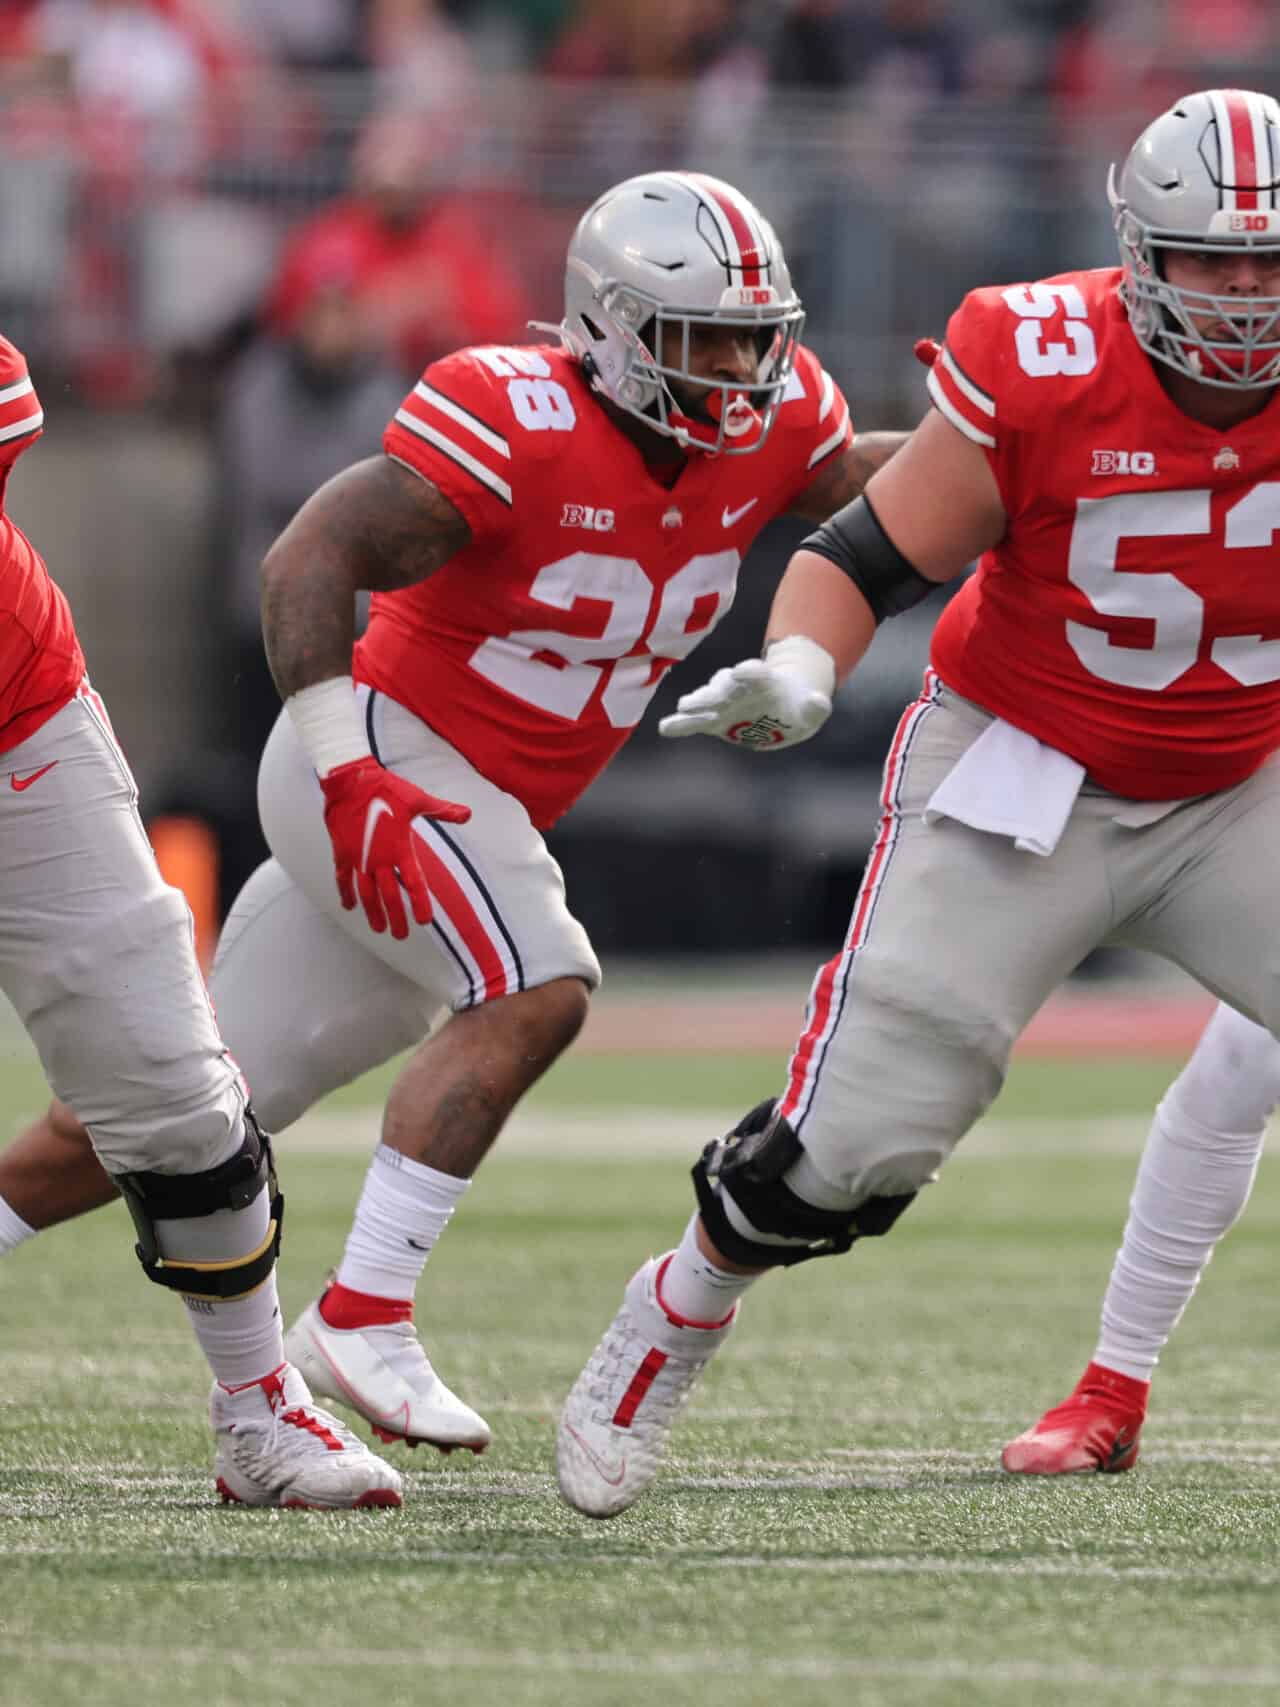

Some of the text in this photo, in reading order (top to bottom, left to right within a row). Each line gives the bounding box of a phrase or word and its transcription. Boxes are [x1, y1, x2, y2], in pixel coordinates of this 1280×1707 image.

[1001, 283, 1098, 378] 53
[466, 347, 577, 432] 28
[468, 548, 742, 729] 28
